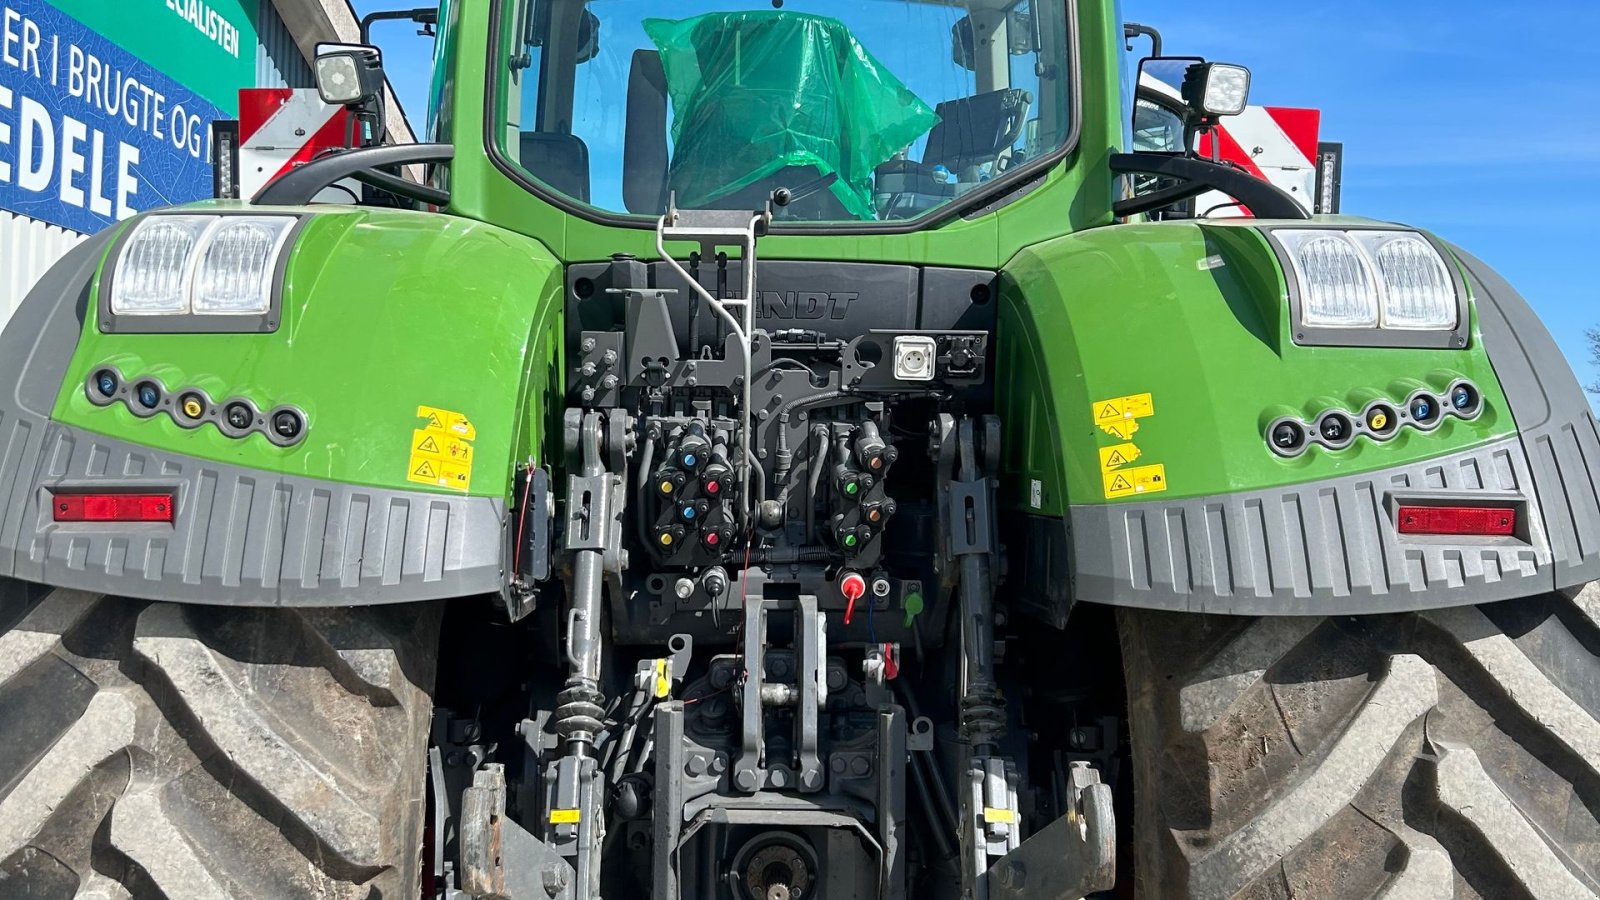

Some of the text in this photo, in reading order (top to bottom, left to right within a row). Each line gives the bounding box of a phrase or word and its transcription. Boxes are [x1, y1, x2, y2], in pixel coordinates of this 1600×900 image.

[3, 7, 41, 79] ER
[51, 34, 59, 87] I
[68, 44, 165, 140] BRUGTE
[171, 103, 201, 158] OG
